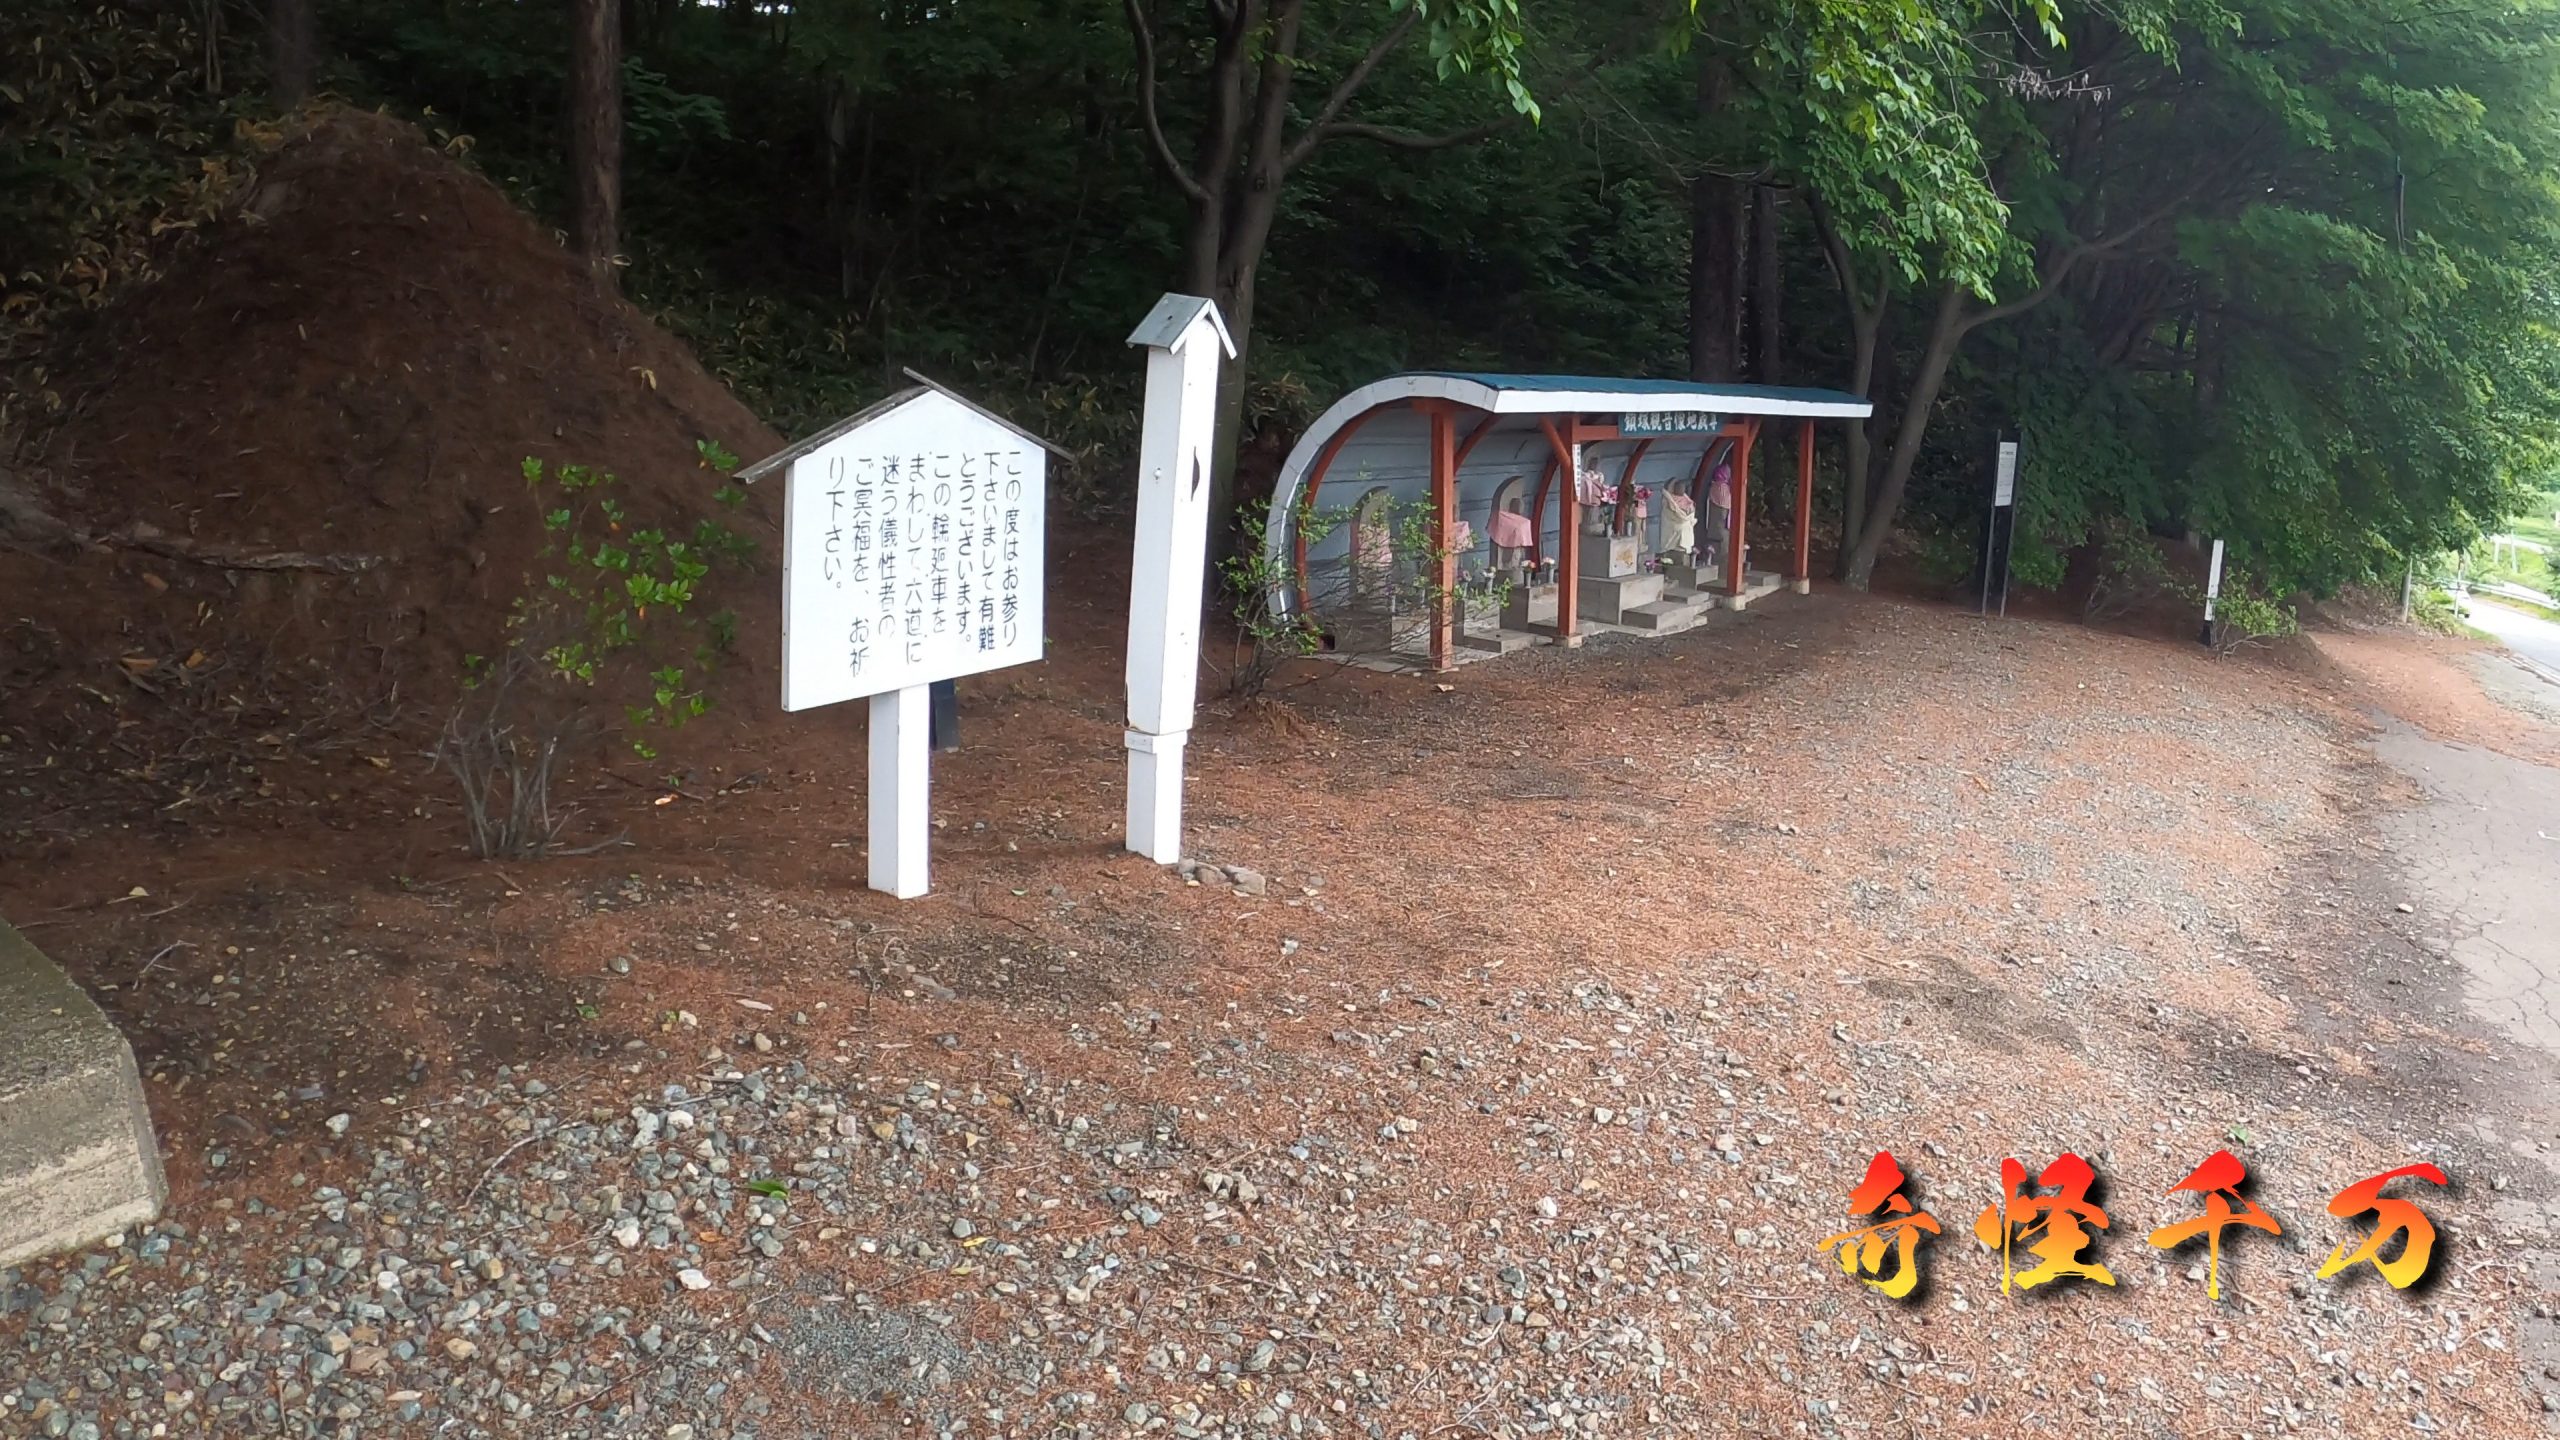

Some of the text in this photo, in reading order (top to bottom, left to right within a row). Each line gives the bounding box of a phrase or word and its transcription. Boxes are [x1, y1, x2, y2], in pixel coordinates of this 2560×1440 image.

[825, 456, 846, 589] り下さい。
[904, 452, 926, 665] まわして六道に
[956, 452, 977, 643] とうございます。
[978, 452, 1001, 654] 下さいまして有難
[1002, 451, 1022, 648] この度はお参り
